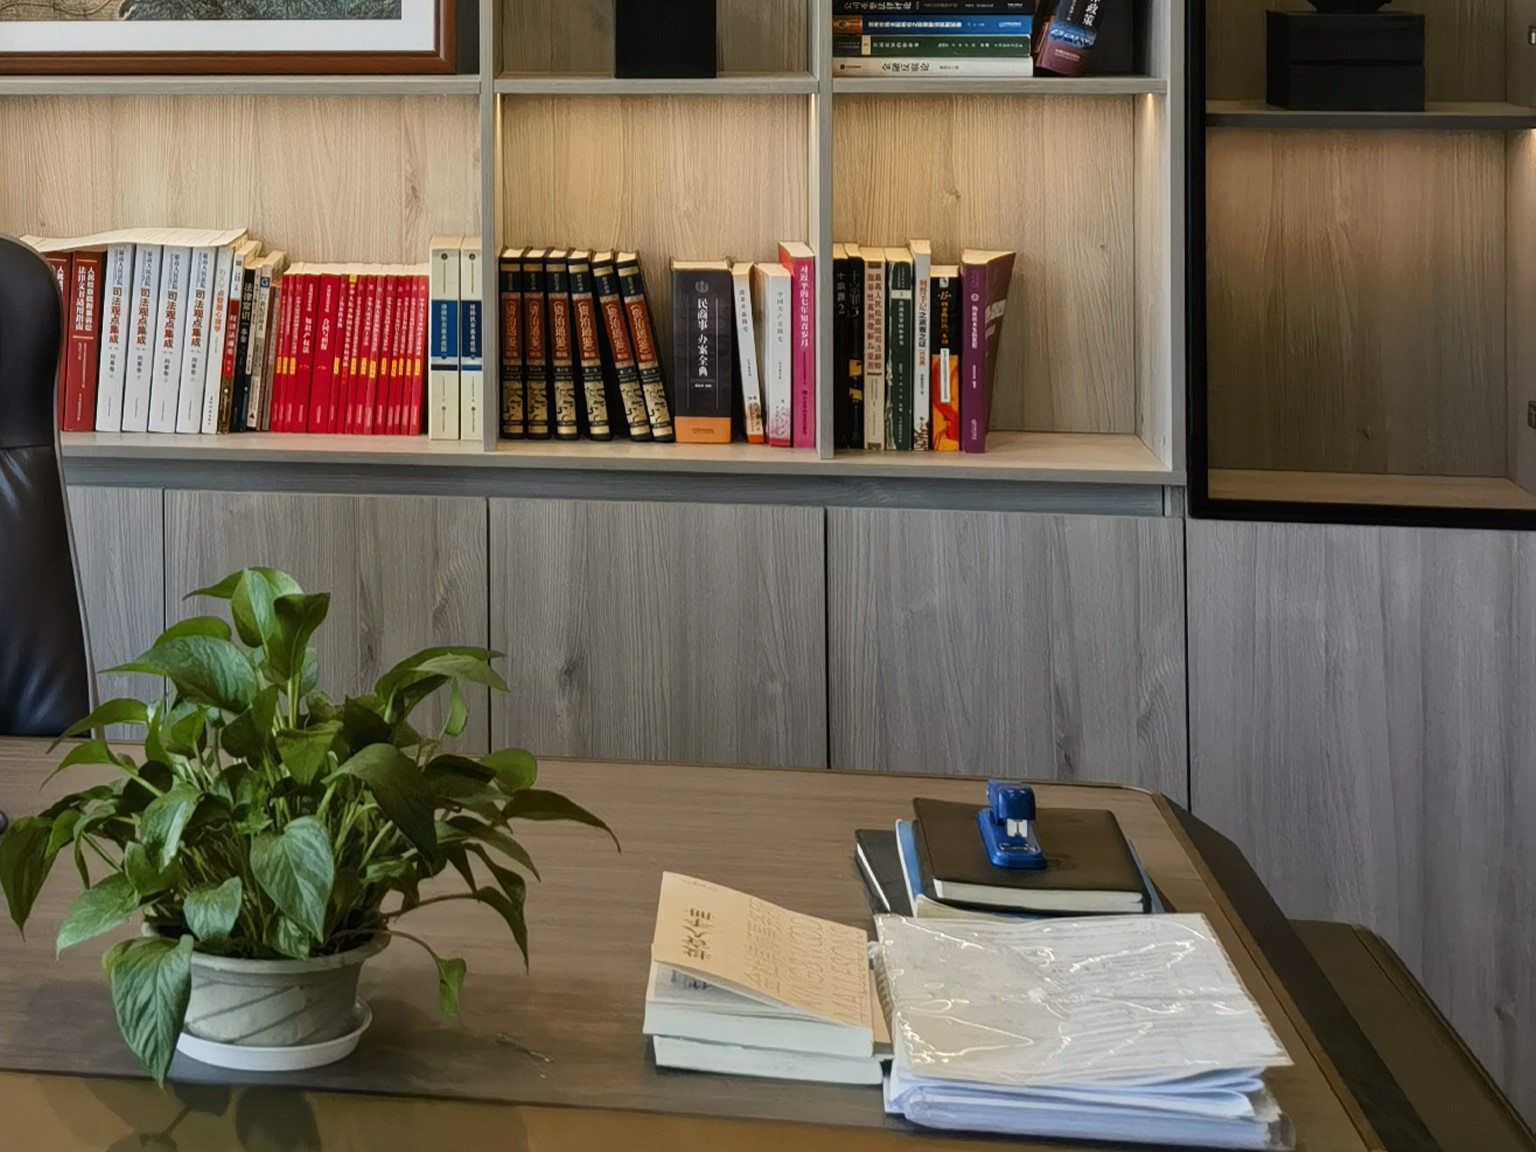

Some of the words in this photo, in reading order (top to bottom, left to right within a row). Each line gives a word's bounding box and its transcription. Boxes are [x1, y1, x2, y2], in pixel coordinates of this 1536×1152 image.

[108, 286, 123, 345] 司法观点集成
[136, 287, 151, 346] 司法观点集成
[162, 290, 178, 349] 司法观点集成
[190, 288, 206, 348] 司法观点集成
[776, 290, 784, 343] 中国共产党简史
[799, 265, 809, 348] 习近平的七年知青岁月
